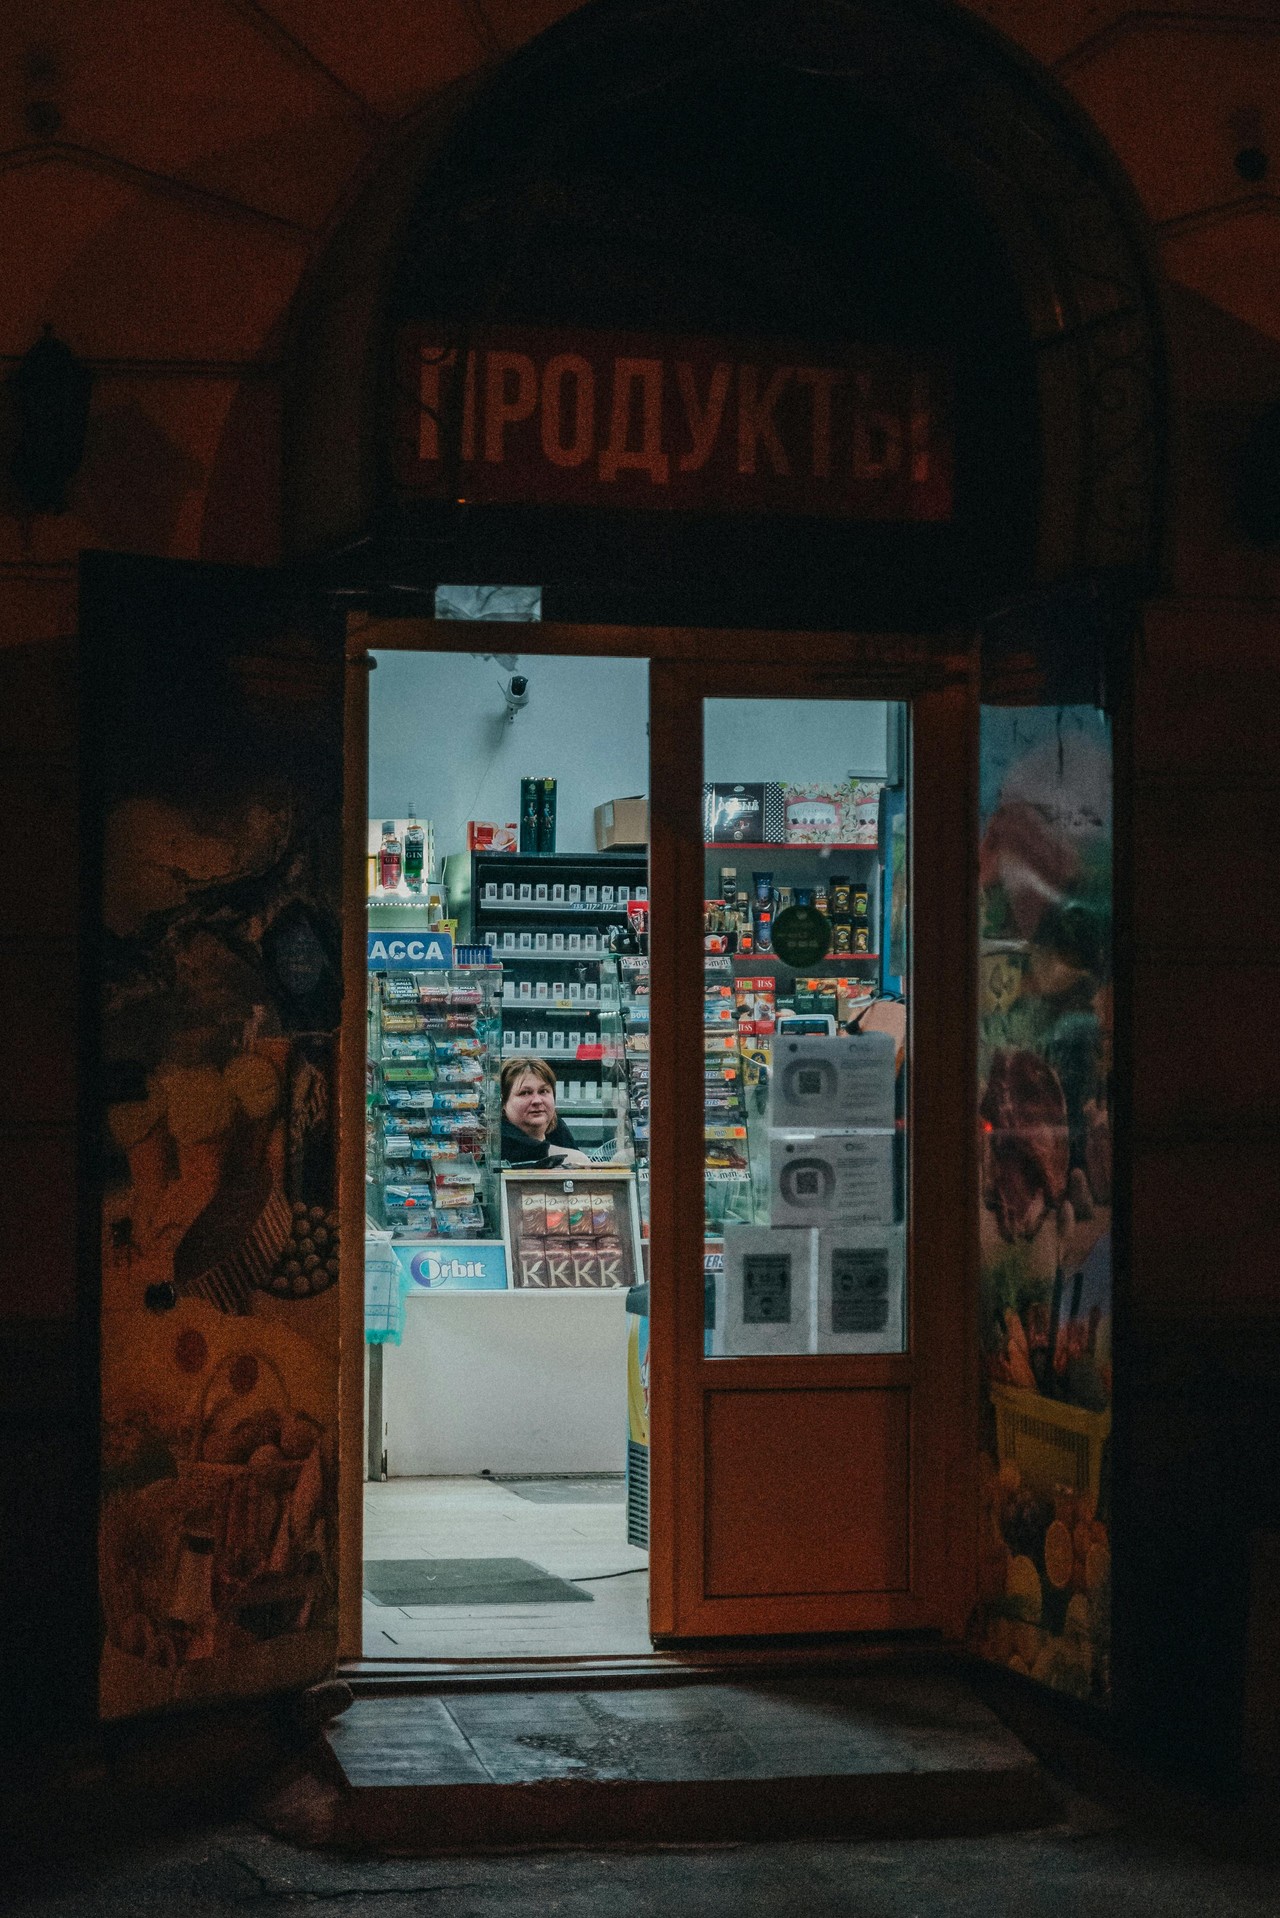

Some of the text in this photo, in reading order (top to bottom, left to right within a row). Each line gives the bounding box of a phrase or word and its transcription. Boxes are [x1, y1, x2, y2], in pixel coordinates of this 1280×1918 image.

[419, 346, 932, 487] ПРОДУКТЫ
[406, 851, 422, 859] GIN
[368, 940, 444, 960] АССА
[757, 980, 773, 988] TESS
[738, 1023, 752, 1031] TESS
[410, 1251, 487, 1288] Orbit
[521, 1260, 546, 1287] K
[549, 1260, 574, 1287] K
[574, 1260, 599, 1287] K
